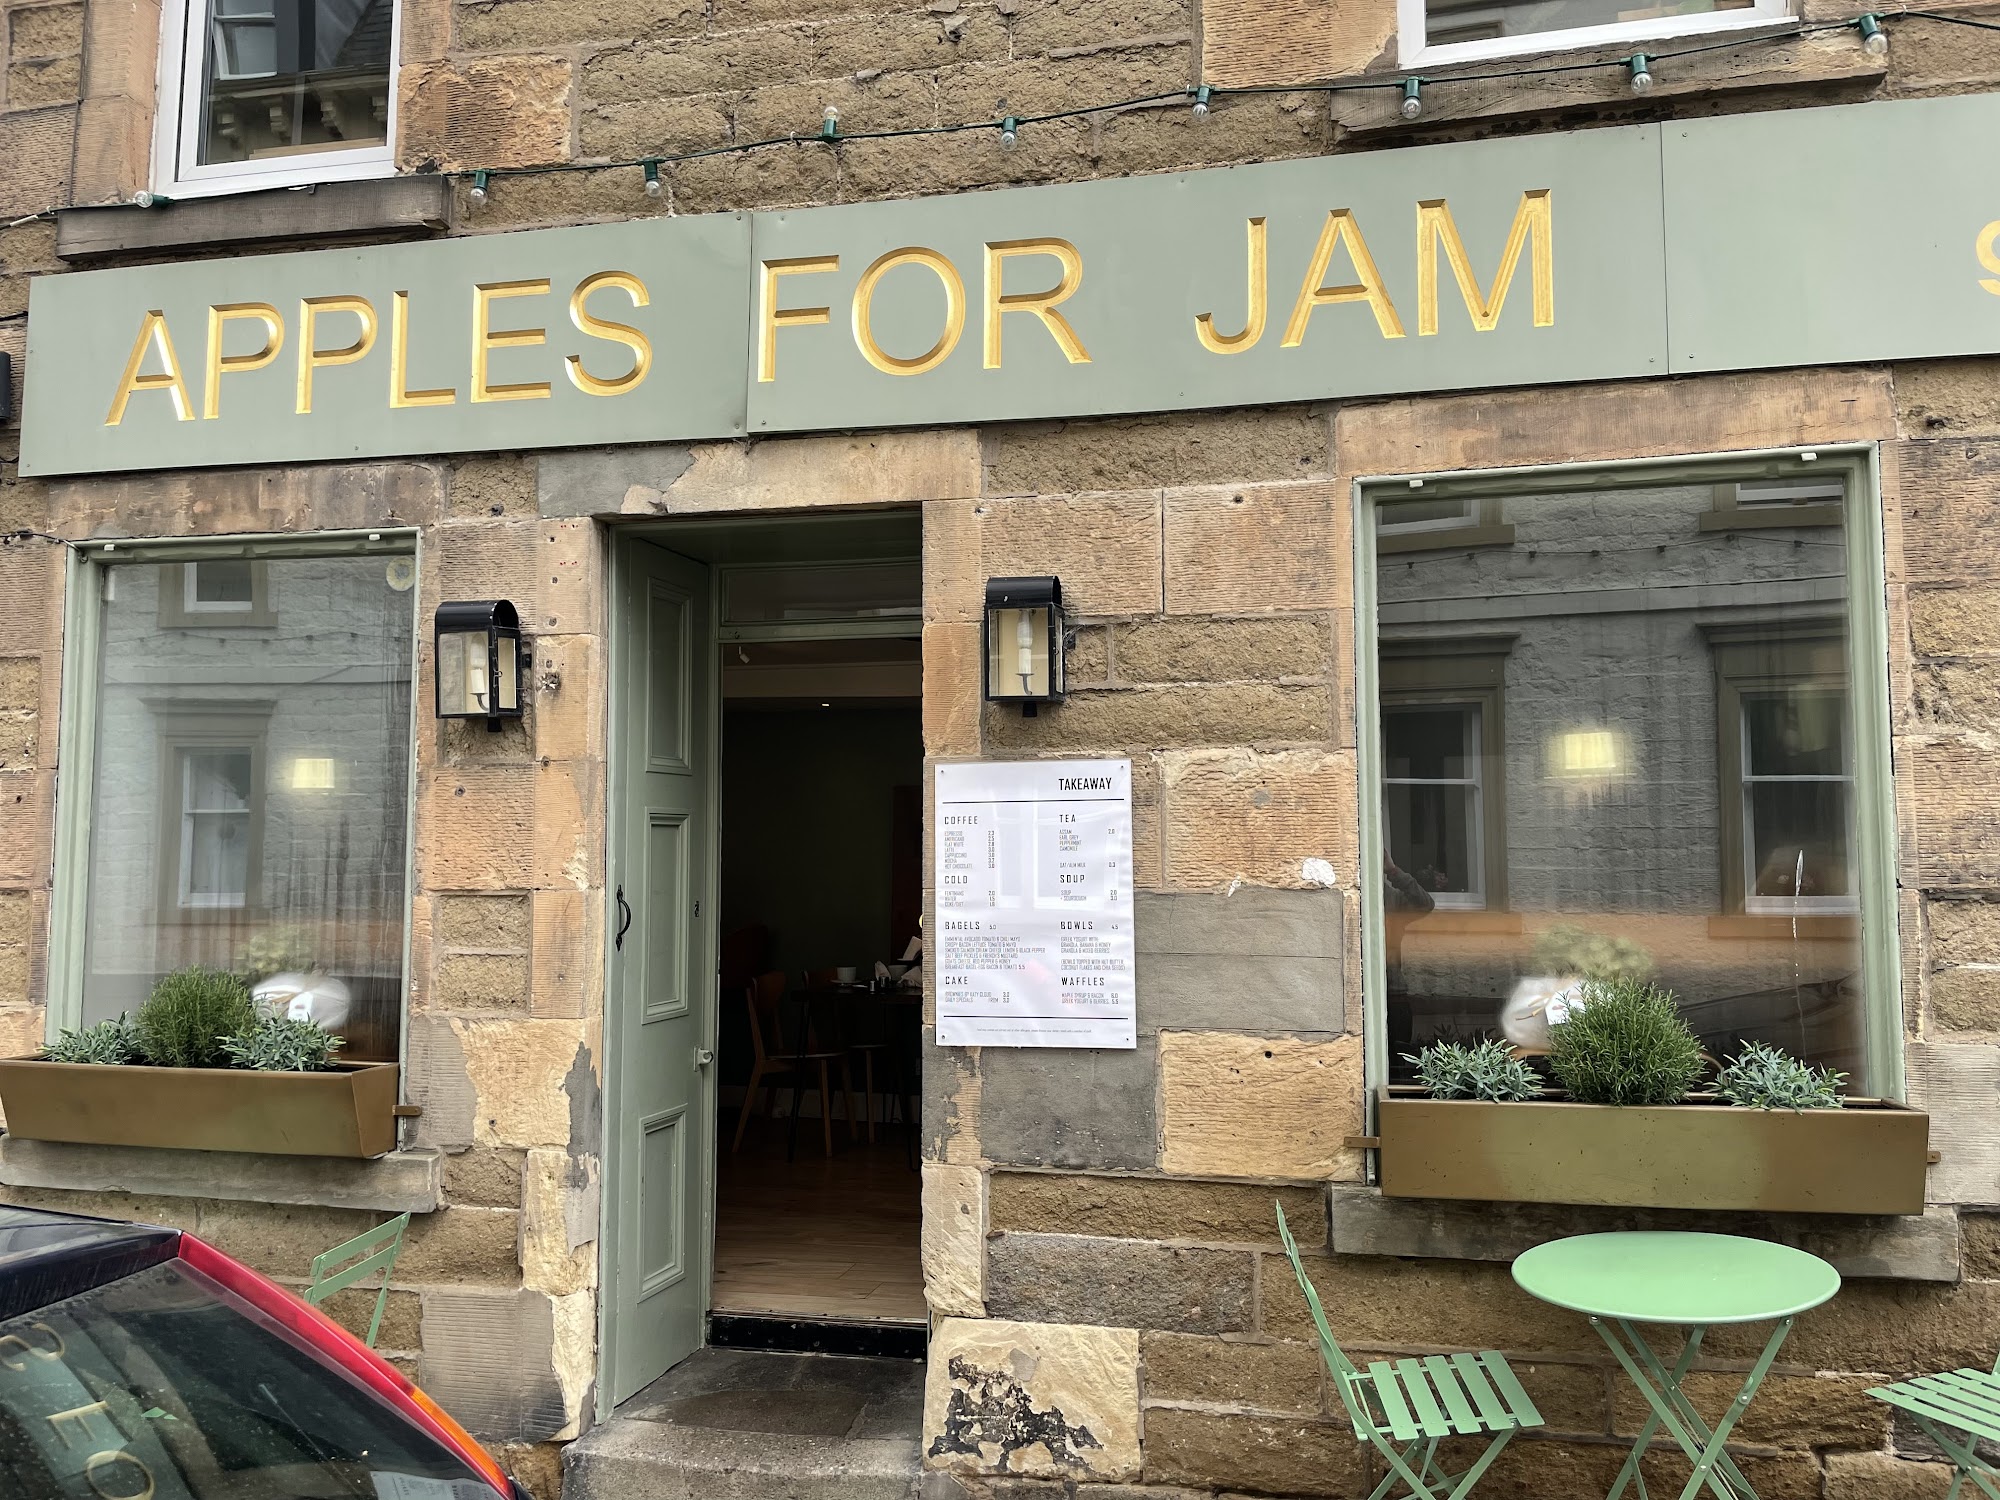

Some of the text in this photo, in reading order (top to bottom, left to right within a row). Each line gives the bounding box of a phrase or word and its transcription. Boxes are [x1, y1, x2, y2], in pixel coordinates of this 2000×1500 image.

[103, 188, 1555, 427] APPLES FOR JAM
[1059, 777, 1112, 791] TAKEAWAY
[945, 816, 978, 824] COFFEE
[1059, 814, 1076, 822] TEA
[945, 875, 968, 884] COLD
[1060, 875, 1085, 883] SOUP
[945, 921, 980, 930] BAGELS
[1060, 921, 1093, 929] BOWLS
[945, 976, 968, 985] CAKE
[1061, 977, 1105, 986] WAFFLES
